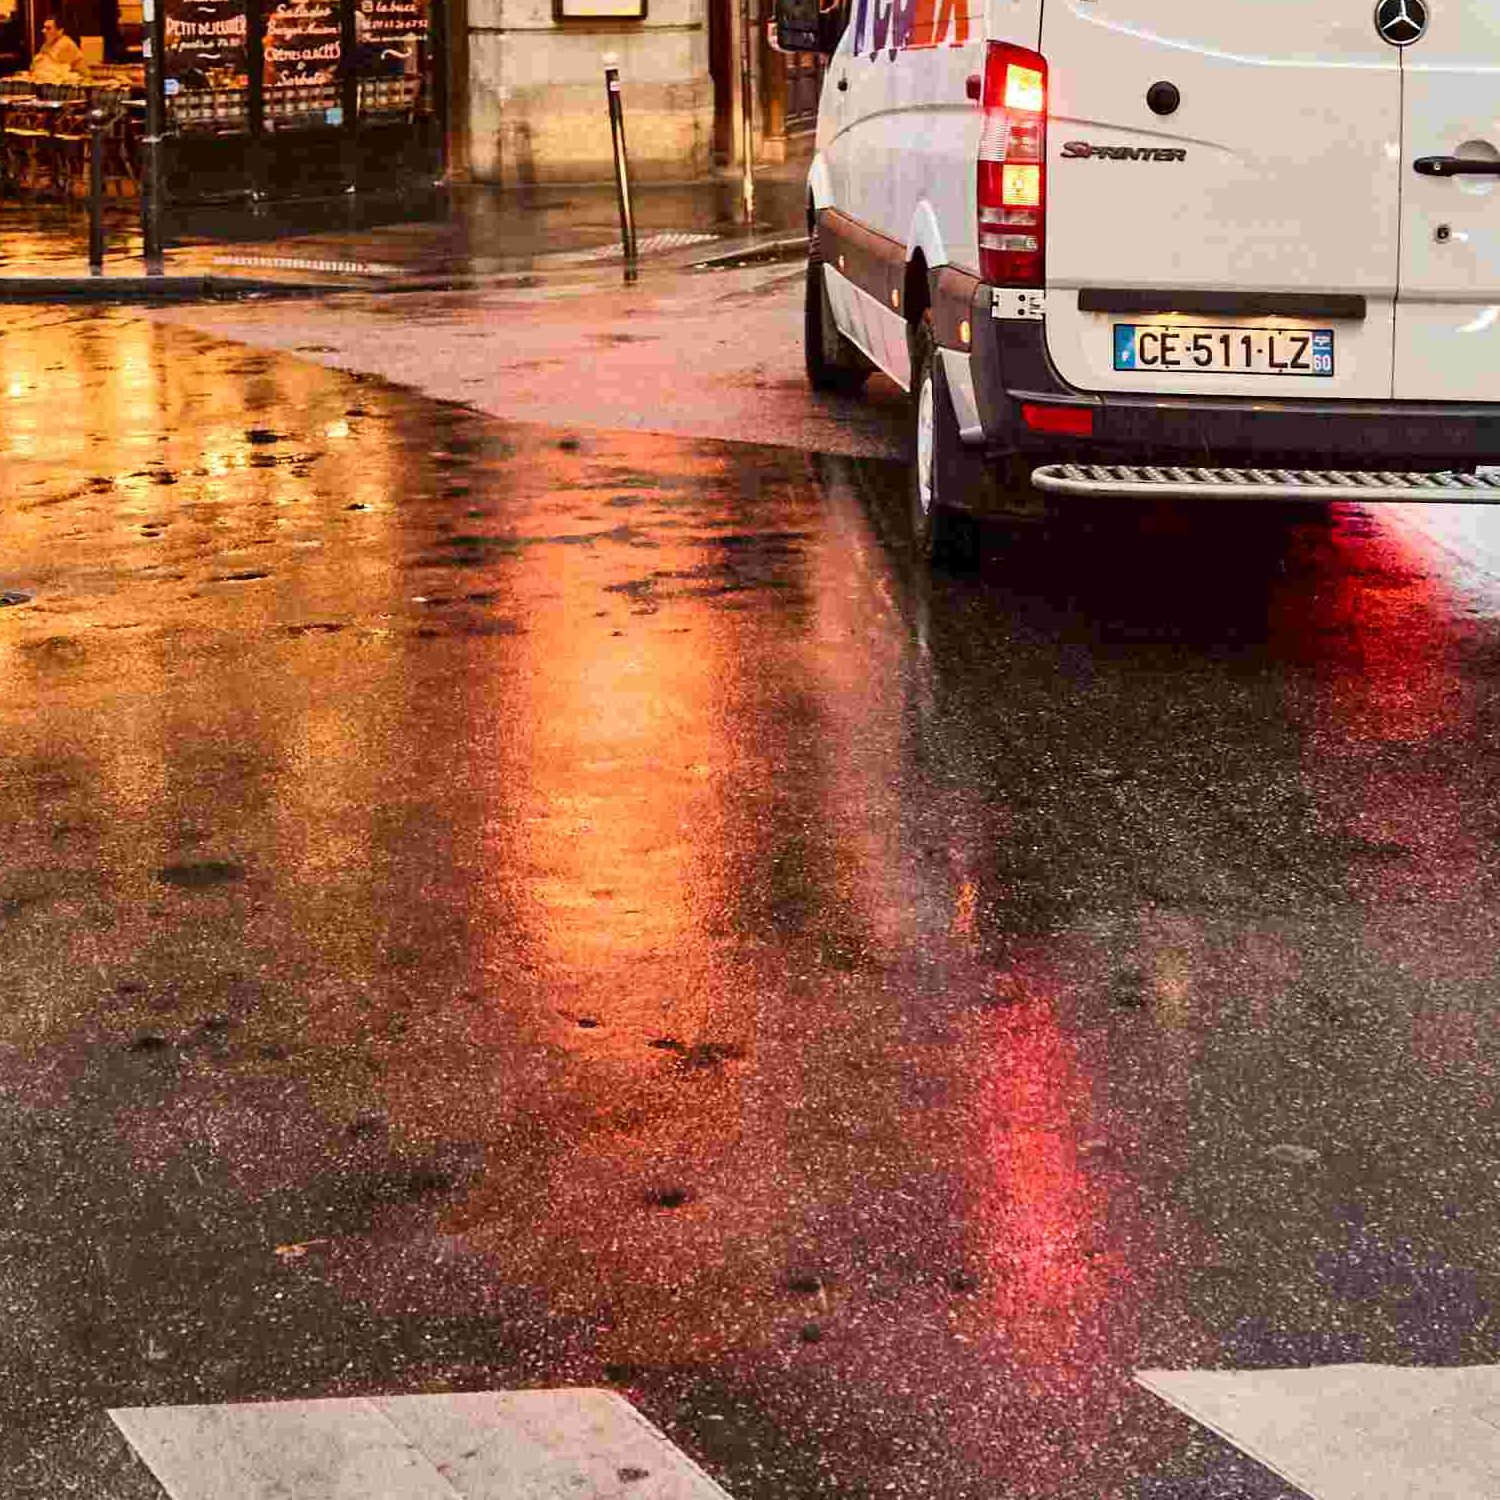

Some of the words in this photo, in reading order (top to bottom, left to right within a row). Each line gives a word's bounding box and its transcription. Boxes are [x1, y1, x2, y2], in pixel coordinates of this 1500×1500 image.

[1060, 141, 1187, 162] SPRINTER
[1139, 332, 1311, 370] CE-511-LZ
[1314, 353, 1333, 371] 60
